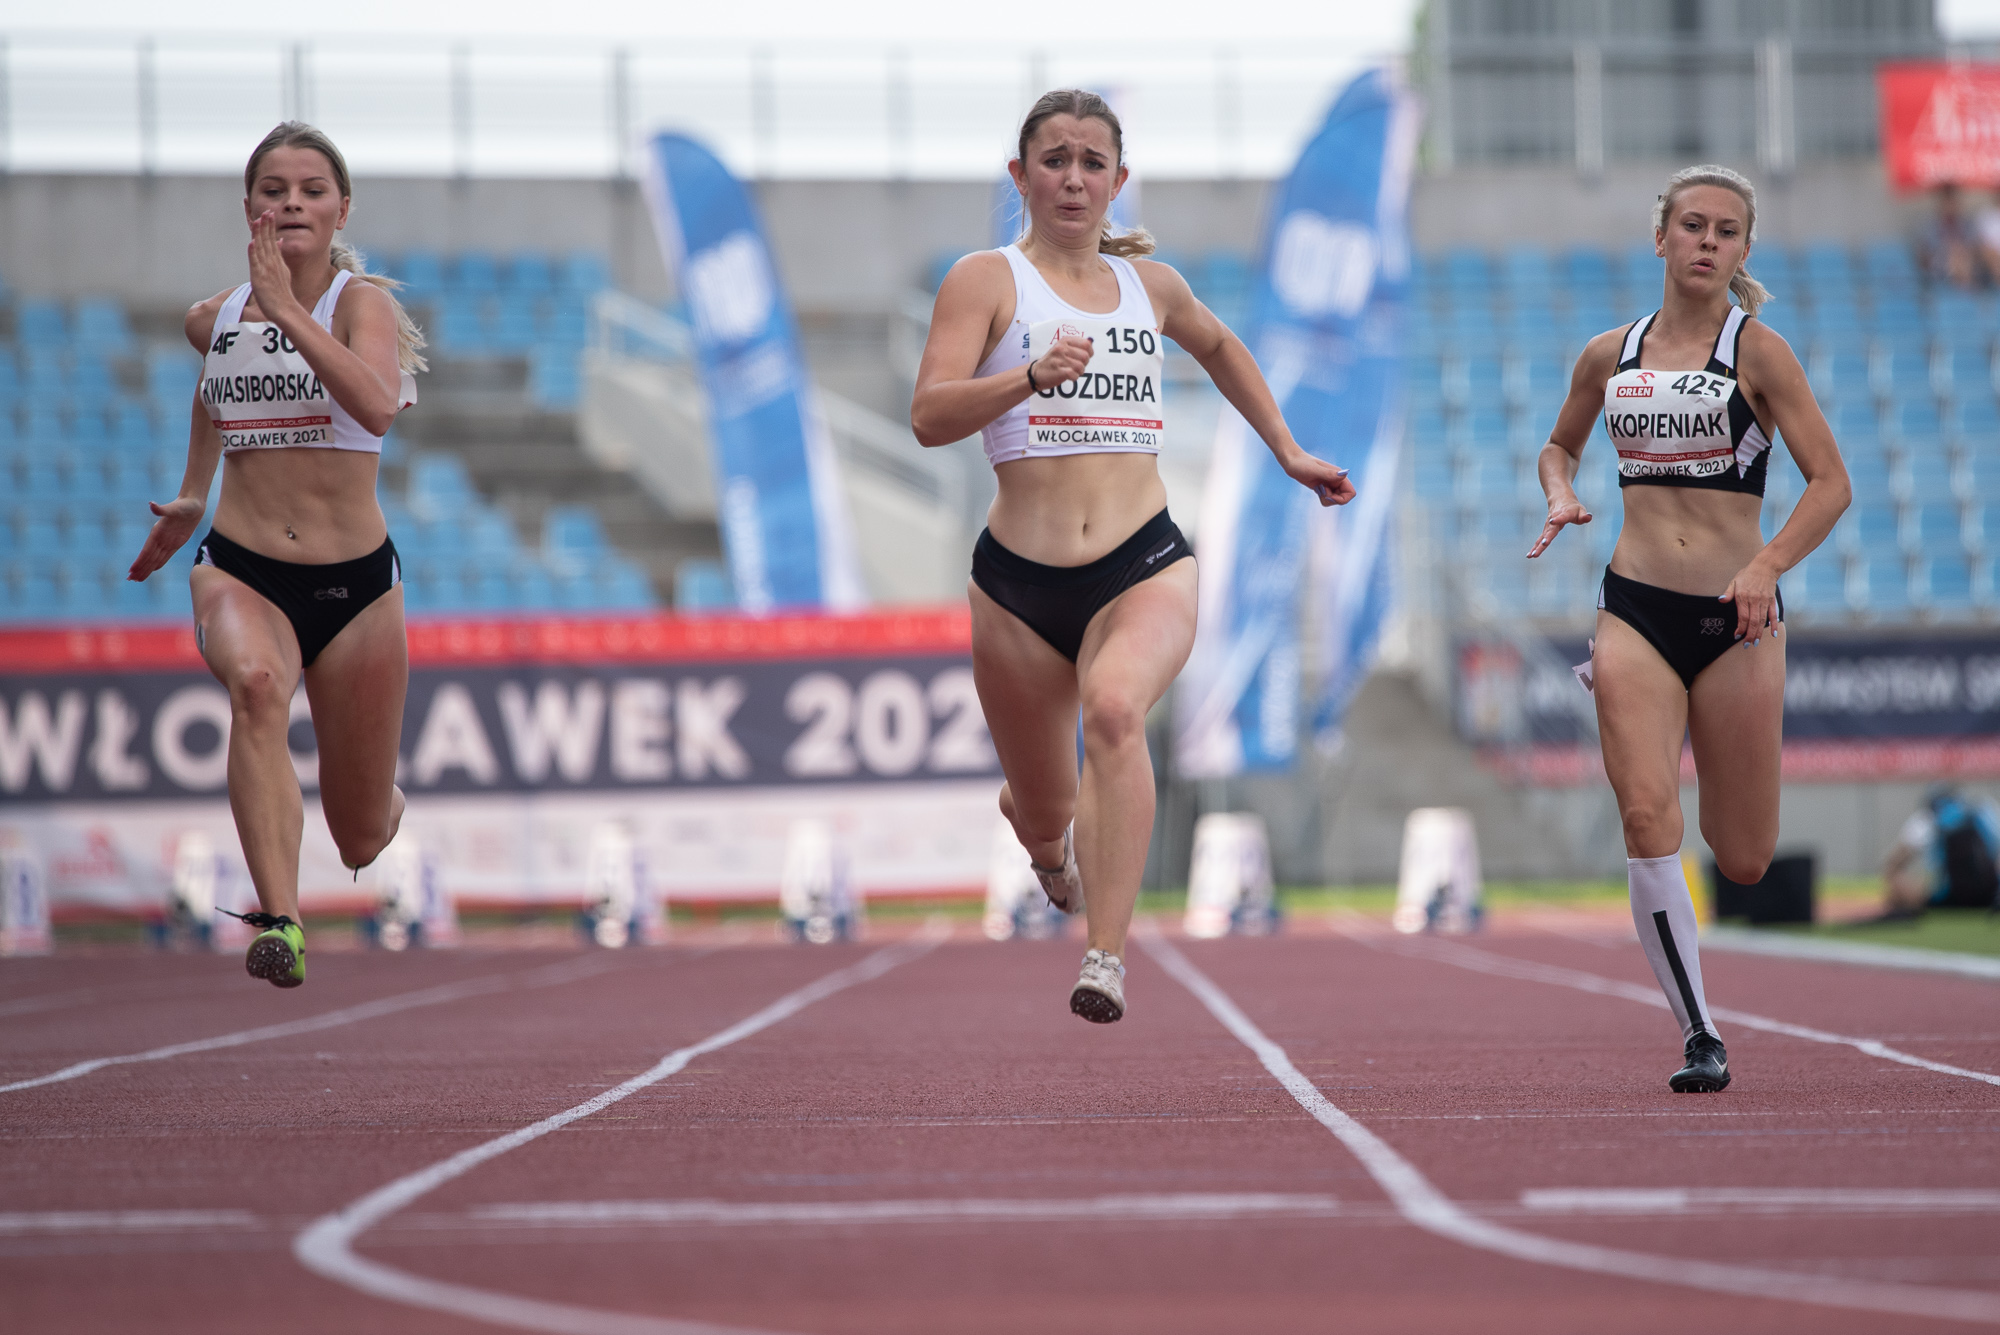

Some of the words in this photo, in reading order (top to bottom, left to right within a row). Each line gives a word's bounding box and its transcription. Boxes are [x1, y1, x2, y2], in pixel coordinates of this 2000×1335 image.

[211, 331, 240, 355] 4F
[1106, 327, 1156, 356] 150
[203, 373, 324, 405] KWASIBORSKA
[1618, 387, 1652, 397] ORLEN
[1671, 374, 1725, 398] 425
[228, 419, 283, 429] MISTRZOSTWA
[283, 418, 311, 427] POLSKI
[1072, 418, 1122, 426] MISTRZOSTWA
[1610, 412, 1726, 439] KOPIENIAK
[222, 432, 289, 448] OCŁAWEK
[292, 428, 326, 444] 2021
[1037, 430, 1129, 443] WŁOCŁAWEK
[1131, 431, 1157, 446] 2021
[1687, 451, 1712, 459] POLSKI
[1622, 461, 1692, 476] WŁOCŁAWEK
[1696, 459, 1727, 475] 2021
[0, 674, 752, 796] WŁOAWEK
